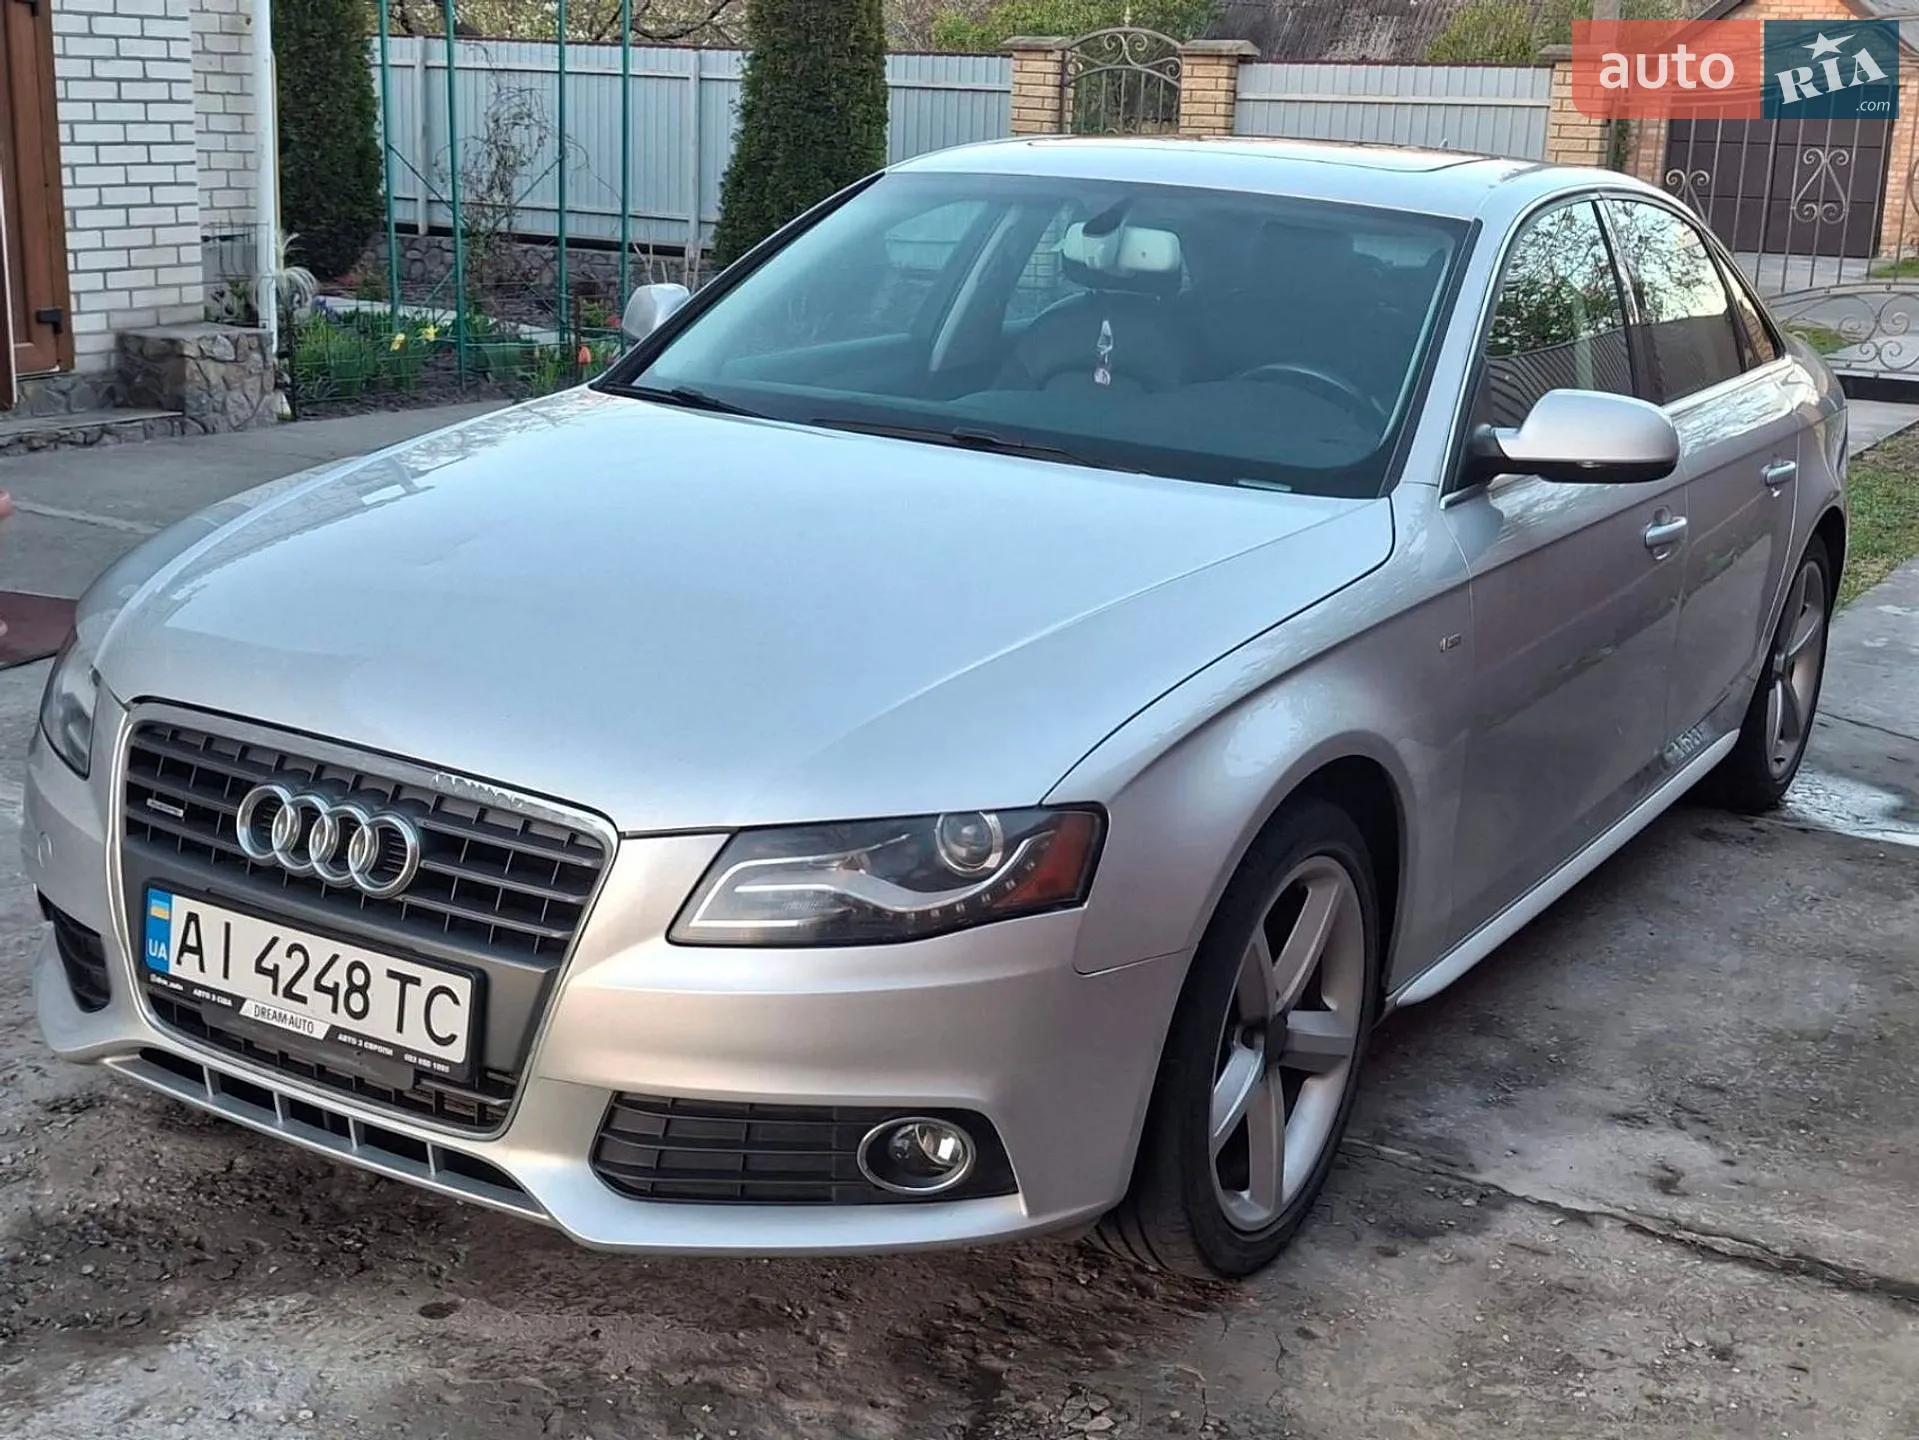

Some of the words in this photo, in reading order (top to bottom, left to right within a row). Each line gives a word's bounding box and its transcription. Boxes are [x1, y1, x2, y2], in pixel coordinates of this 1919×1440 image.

[149, 939, 168, 961] UA
[176, 911, 231, 980] AI
[254, 936, 371, 1021] 4248
[386, 969, 461, 1047] TC
